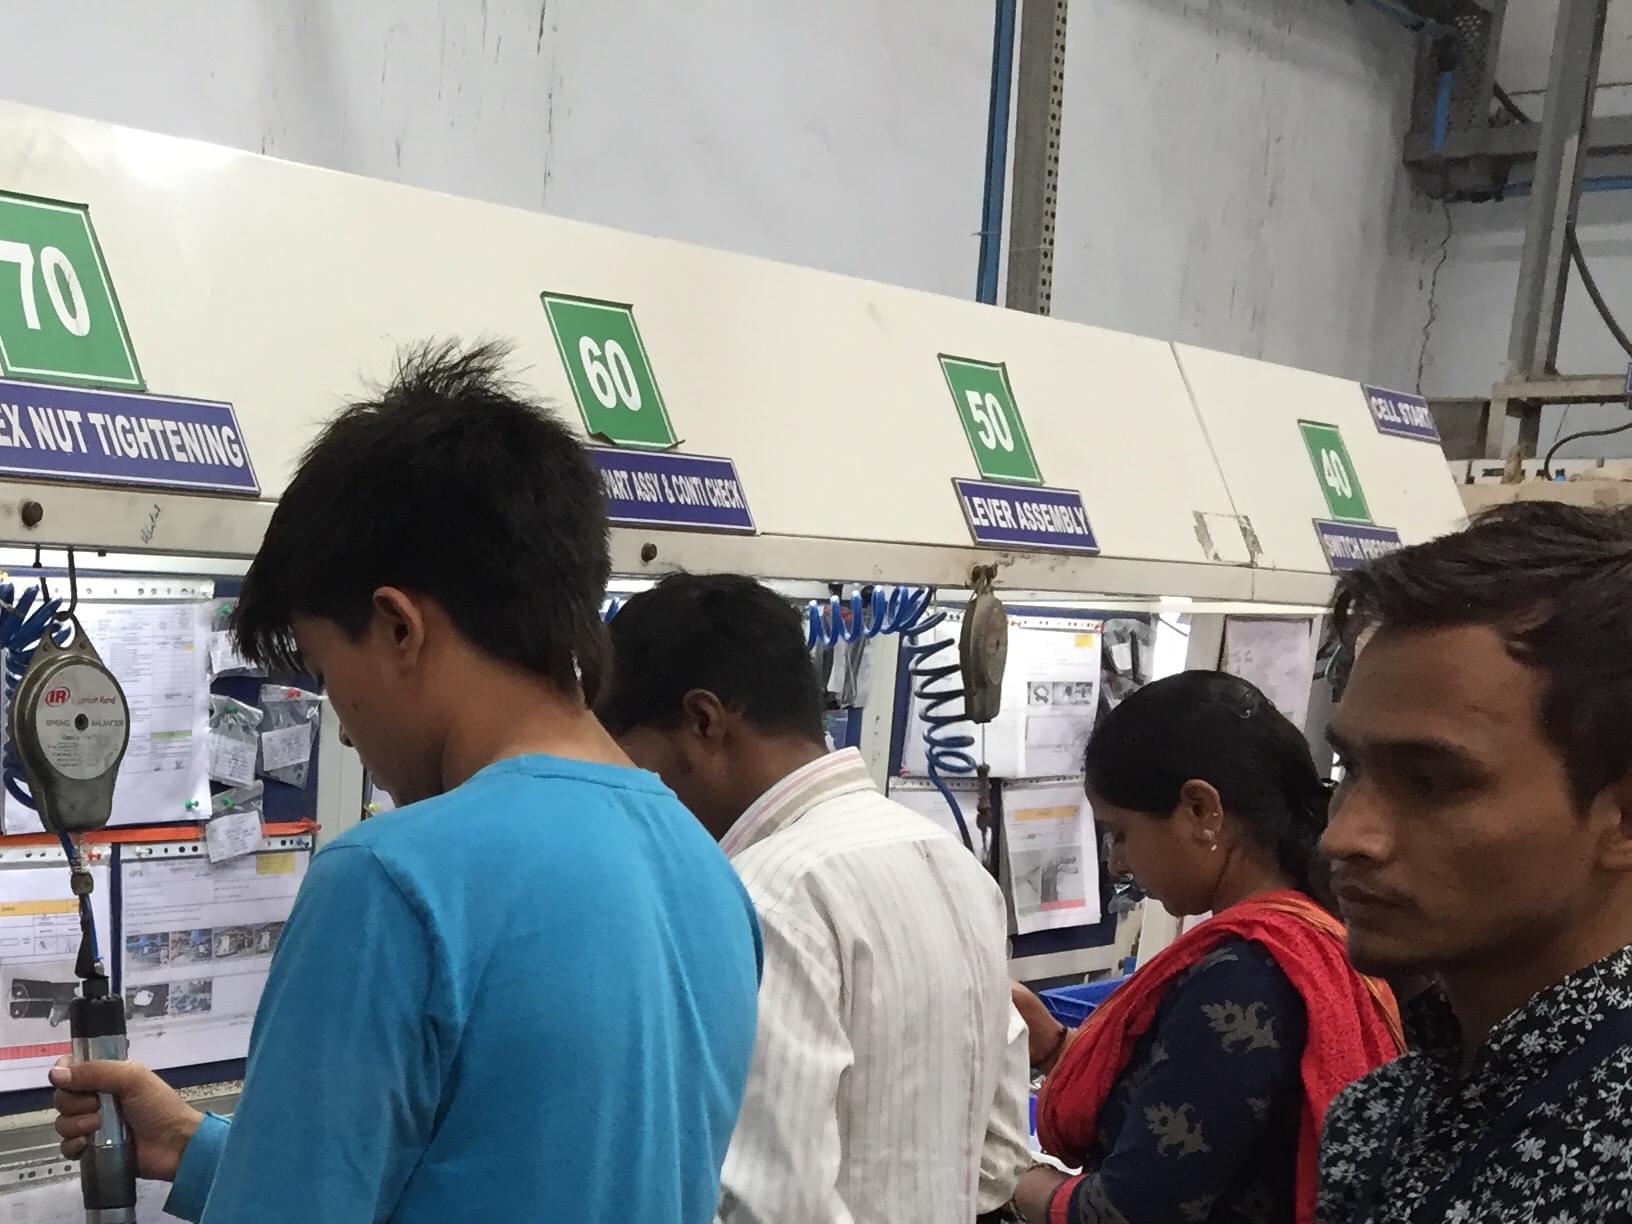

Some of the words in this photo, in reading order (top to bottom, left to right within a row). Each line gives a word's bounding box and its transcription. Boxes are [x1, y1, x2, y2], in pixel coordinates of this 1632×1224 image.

[579, 336, 642, 411] 60
[28, 406, 88, 454] NUT
[88, 412, 245, 468] TIGHTENING
[965, 390, 1014, 452] 50
[1371, 396, 1401, 424] CELL
[1397, 402, 1434, 430] START
[631, 472, 664, 503] ASSY
[661, 474, 675, 504] &
[705, 478, 745, 509] CHECK
[1321, 448, 1353, 498] 40
[964, 496, 1017, 528] LEVER
[1015, 501, 1089, 535] ASSEMBLY
